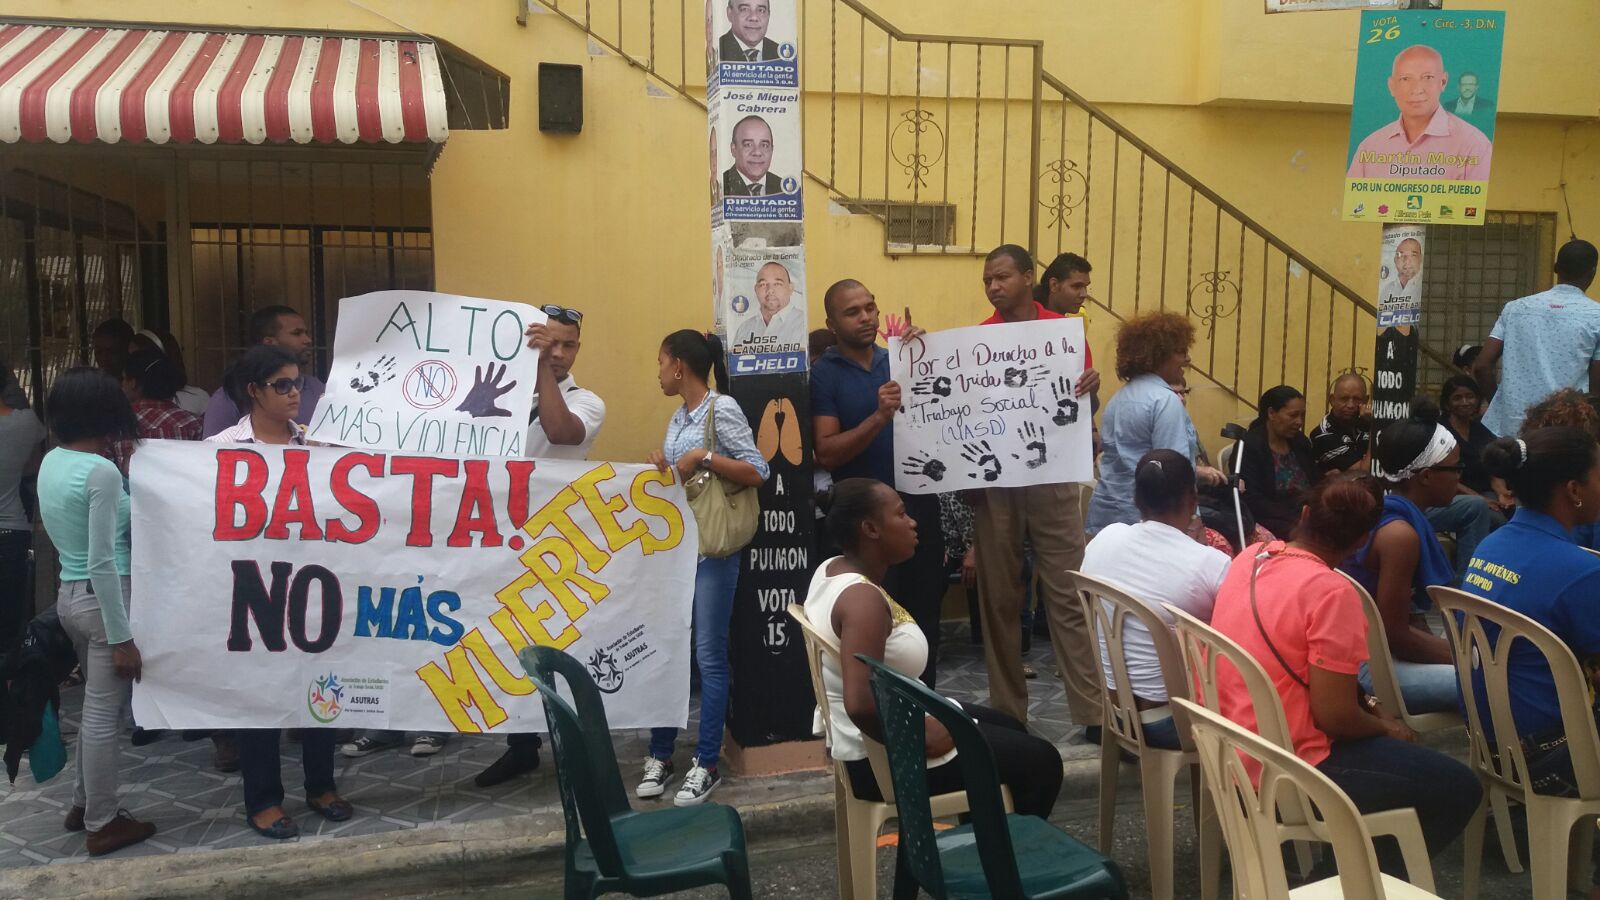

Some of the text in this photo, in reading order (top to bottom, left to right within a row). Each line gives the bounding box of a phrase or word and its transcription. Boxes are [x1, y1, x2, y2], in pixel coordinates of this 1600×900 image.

[1373, 16, 1397, 27] VOTA
[1366, 25, 1400, 44] 26
[722, 64, 795, 72] DIPUTADO
[723, 91, 798, 103] José Miguel
[737, 104, 787, 114] Cabrera
[1389, 163, 1446, 177] Diputado
[1427, 152, 1480, 168] Moya
[1351, 182, 1481, 195] POR UN CONGRESO DEL PUEBLO
[375, 301, 523, 361] ALTO
[899, 335, 940, 378] Por
[946, 349, 960, 370] el
[972, 342, 1037, 366] Derecho
[1062, 337, 1077, 354] la
[1386, 341, 1394, 360] A
[415, 366, 447, 399] NO
[1377, 370, 1402, 389] TODO
[911, 388, 1040, 426] Trabajo Social
[311, 400, 521, 457] MÁS VIOLENCIA
[776, 473, 784, 496] A
[212, 448, 536, 551] BASTA!
[763, 510, 795, 533] TODO
[750, 547, 808, 571] PULMON
[227, 559, 466, 654] NO MÁS
[416, 461, 685, 734] MUERTES
[757, 588, 797, 613] VOTA
[767, 622, 787, 646] 15
[624, 642, 648, 662] ASUTRAS
[350, 696, 380, 705] ASUTRAS
